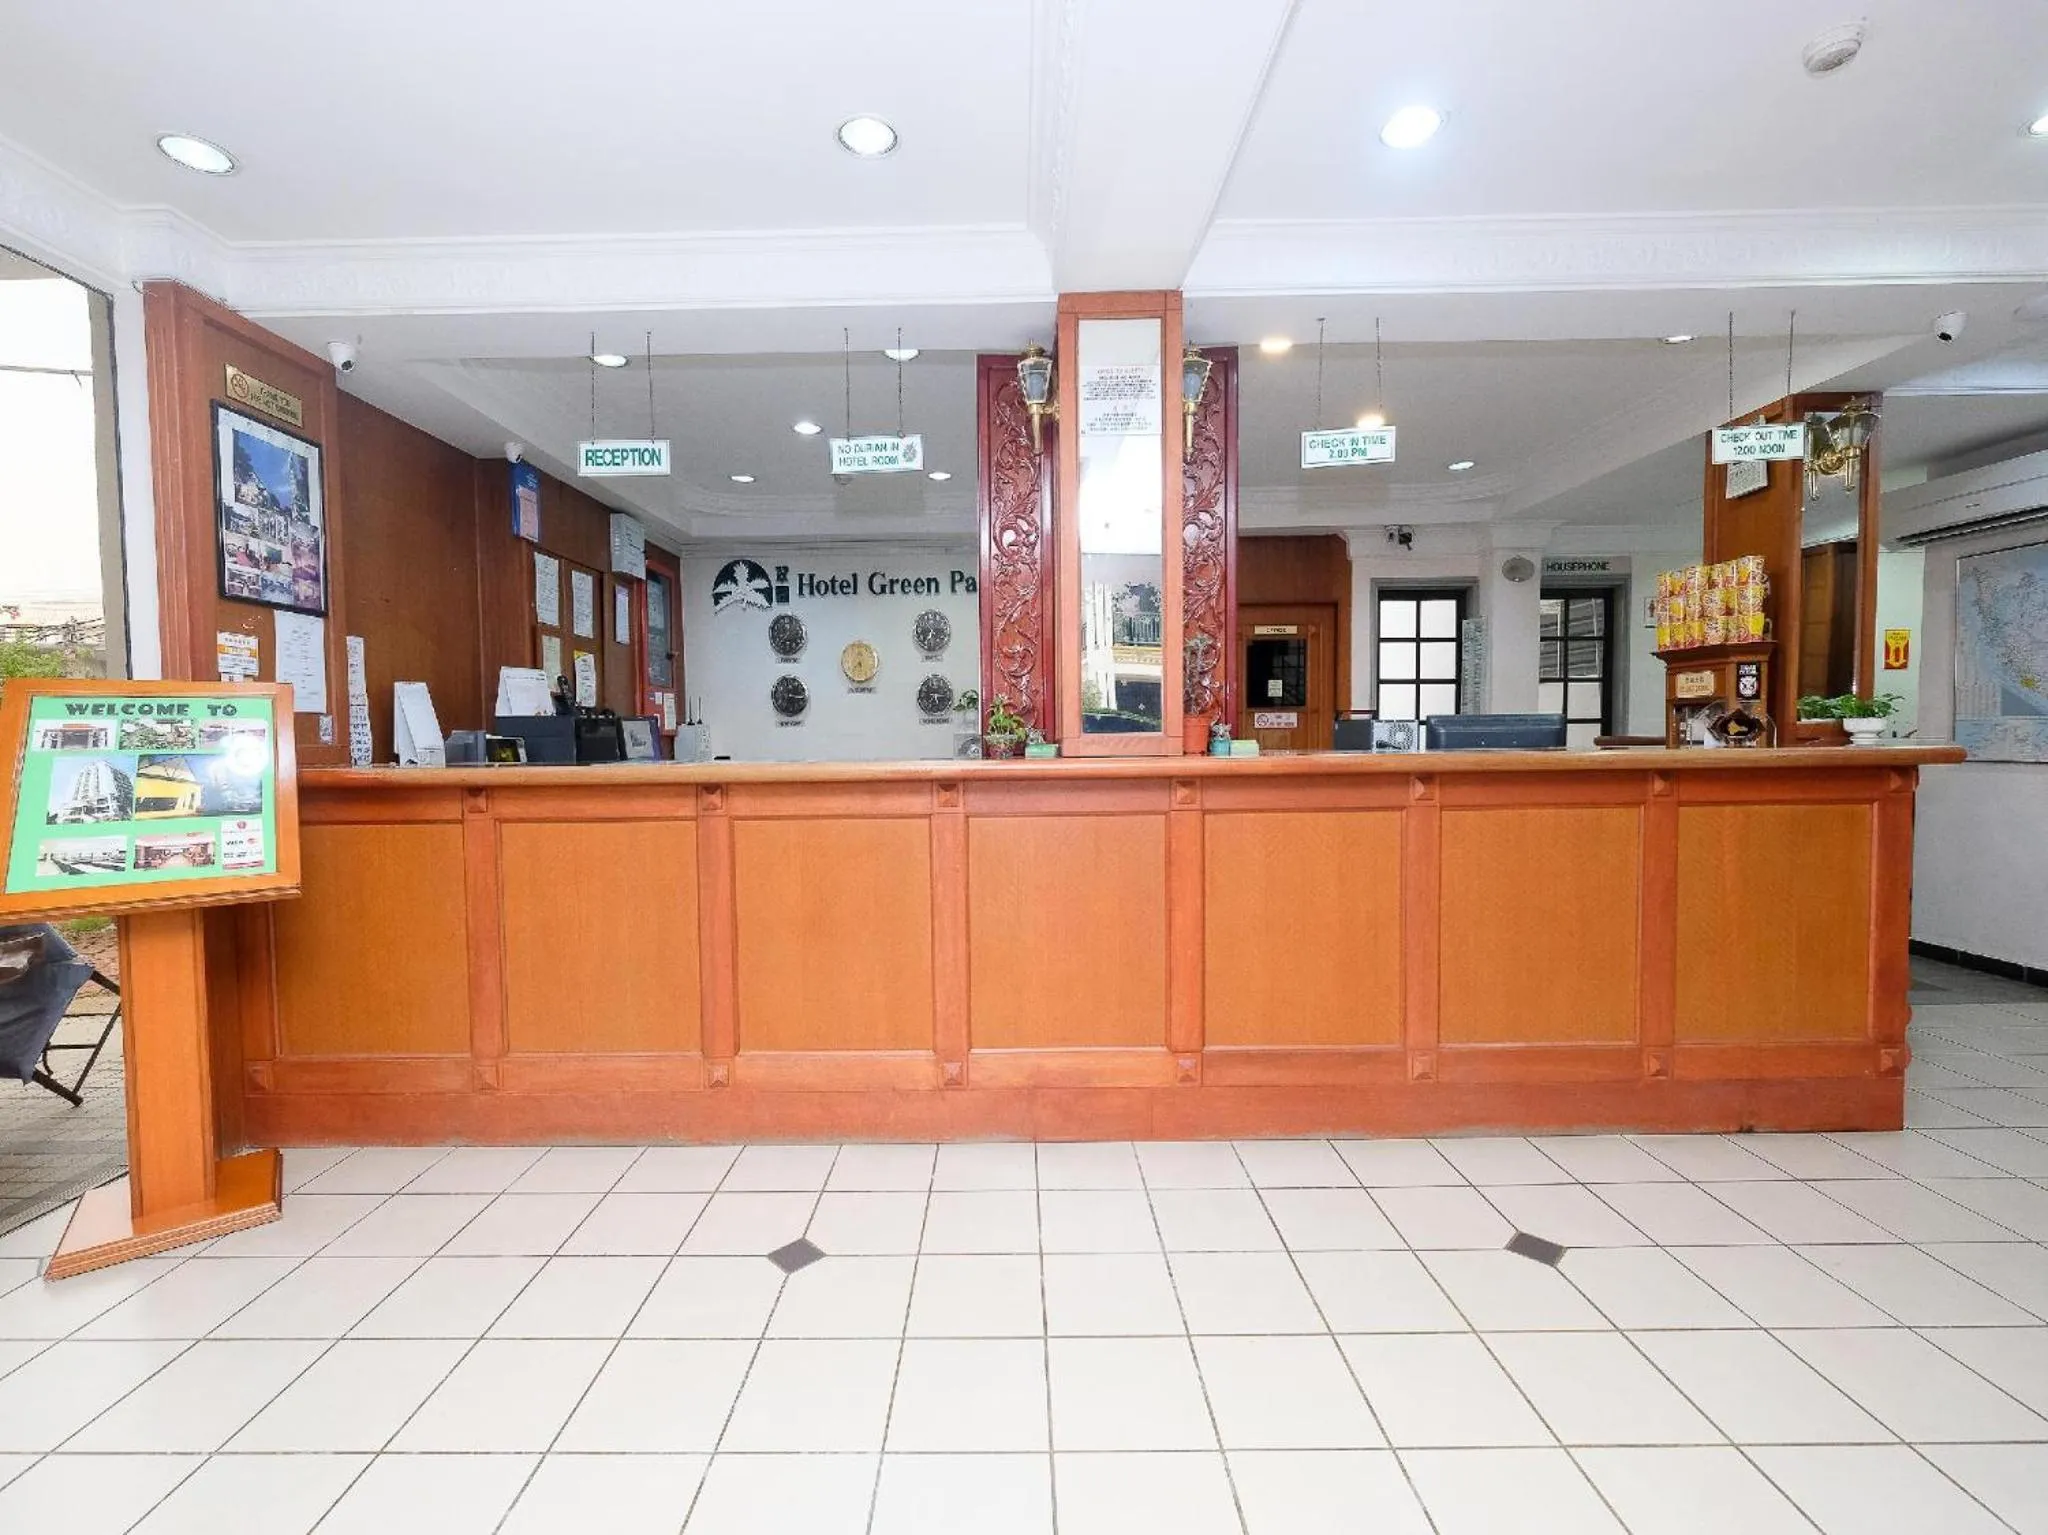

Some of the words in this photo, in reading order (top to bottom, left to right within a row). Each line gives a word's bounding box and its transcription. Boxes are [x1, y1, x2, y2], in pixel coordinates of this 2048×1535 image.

[1308, 438, 1345, 449] CHECK
[1362, 435, 1387, 445] TIME
[1720, 433, 1750, 443] CHECK
[1755, 431, 1773, 441] OUT
[1779, 429, 1798, 440] TIME
[838, 445, 851, 454] NO
[1351, 447, 1368, 457] PM
[1759, 443, 1786, 454] NOON
[585, 448, 662, 466] RECEPTION
[839, 456, 868, 467] HOTEL
[872, 455, 899, 465] ROOM
[1546, 561, 1611, 571] HOUSEPHONE
[797, 573, 858, 596] Hotel
[868, 571, 940, 595] Green
[65, 703, 190, 716] WELCOME
[207, 703, 238, 716] TO
